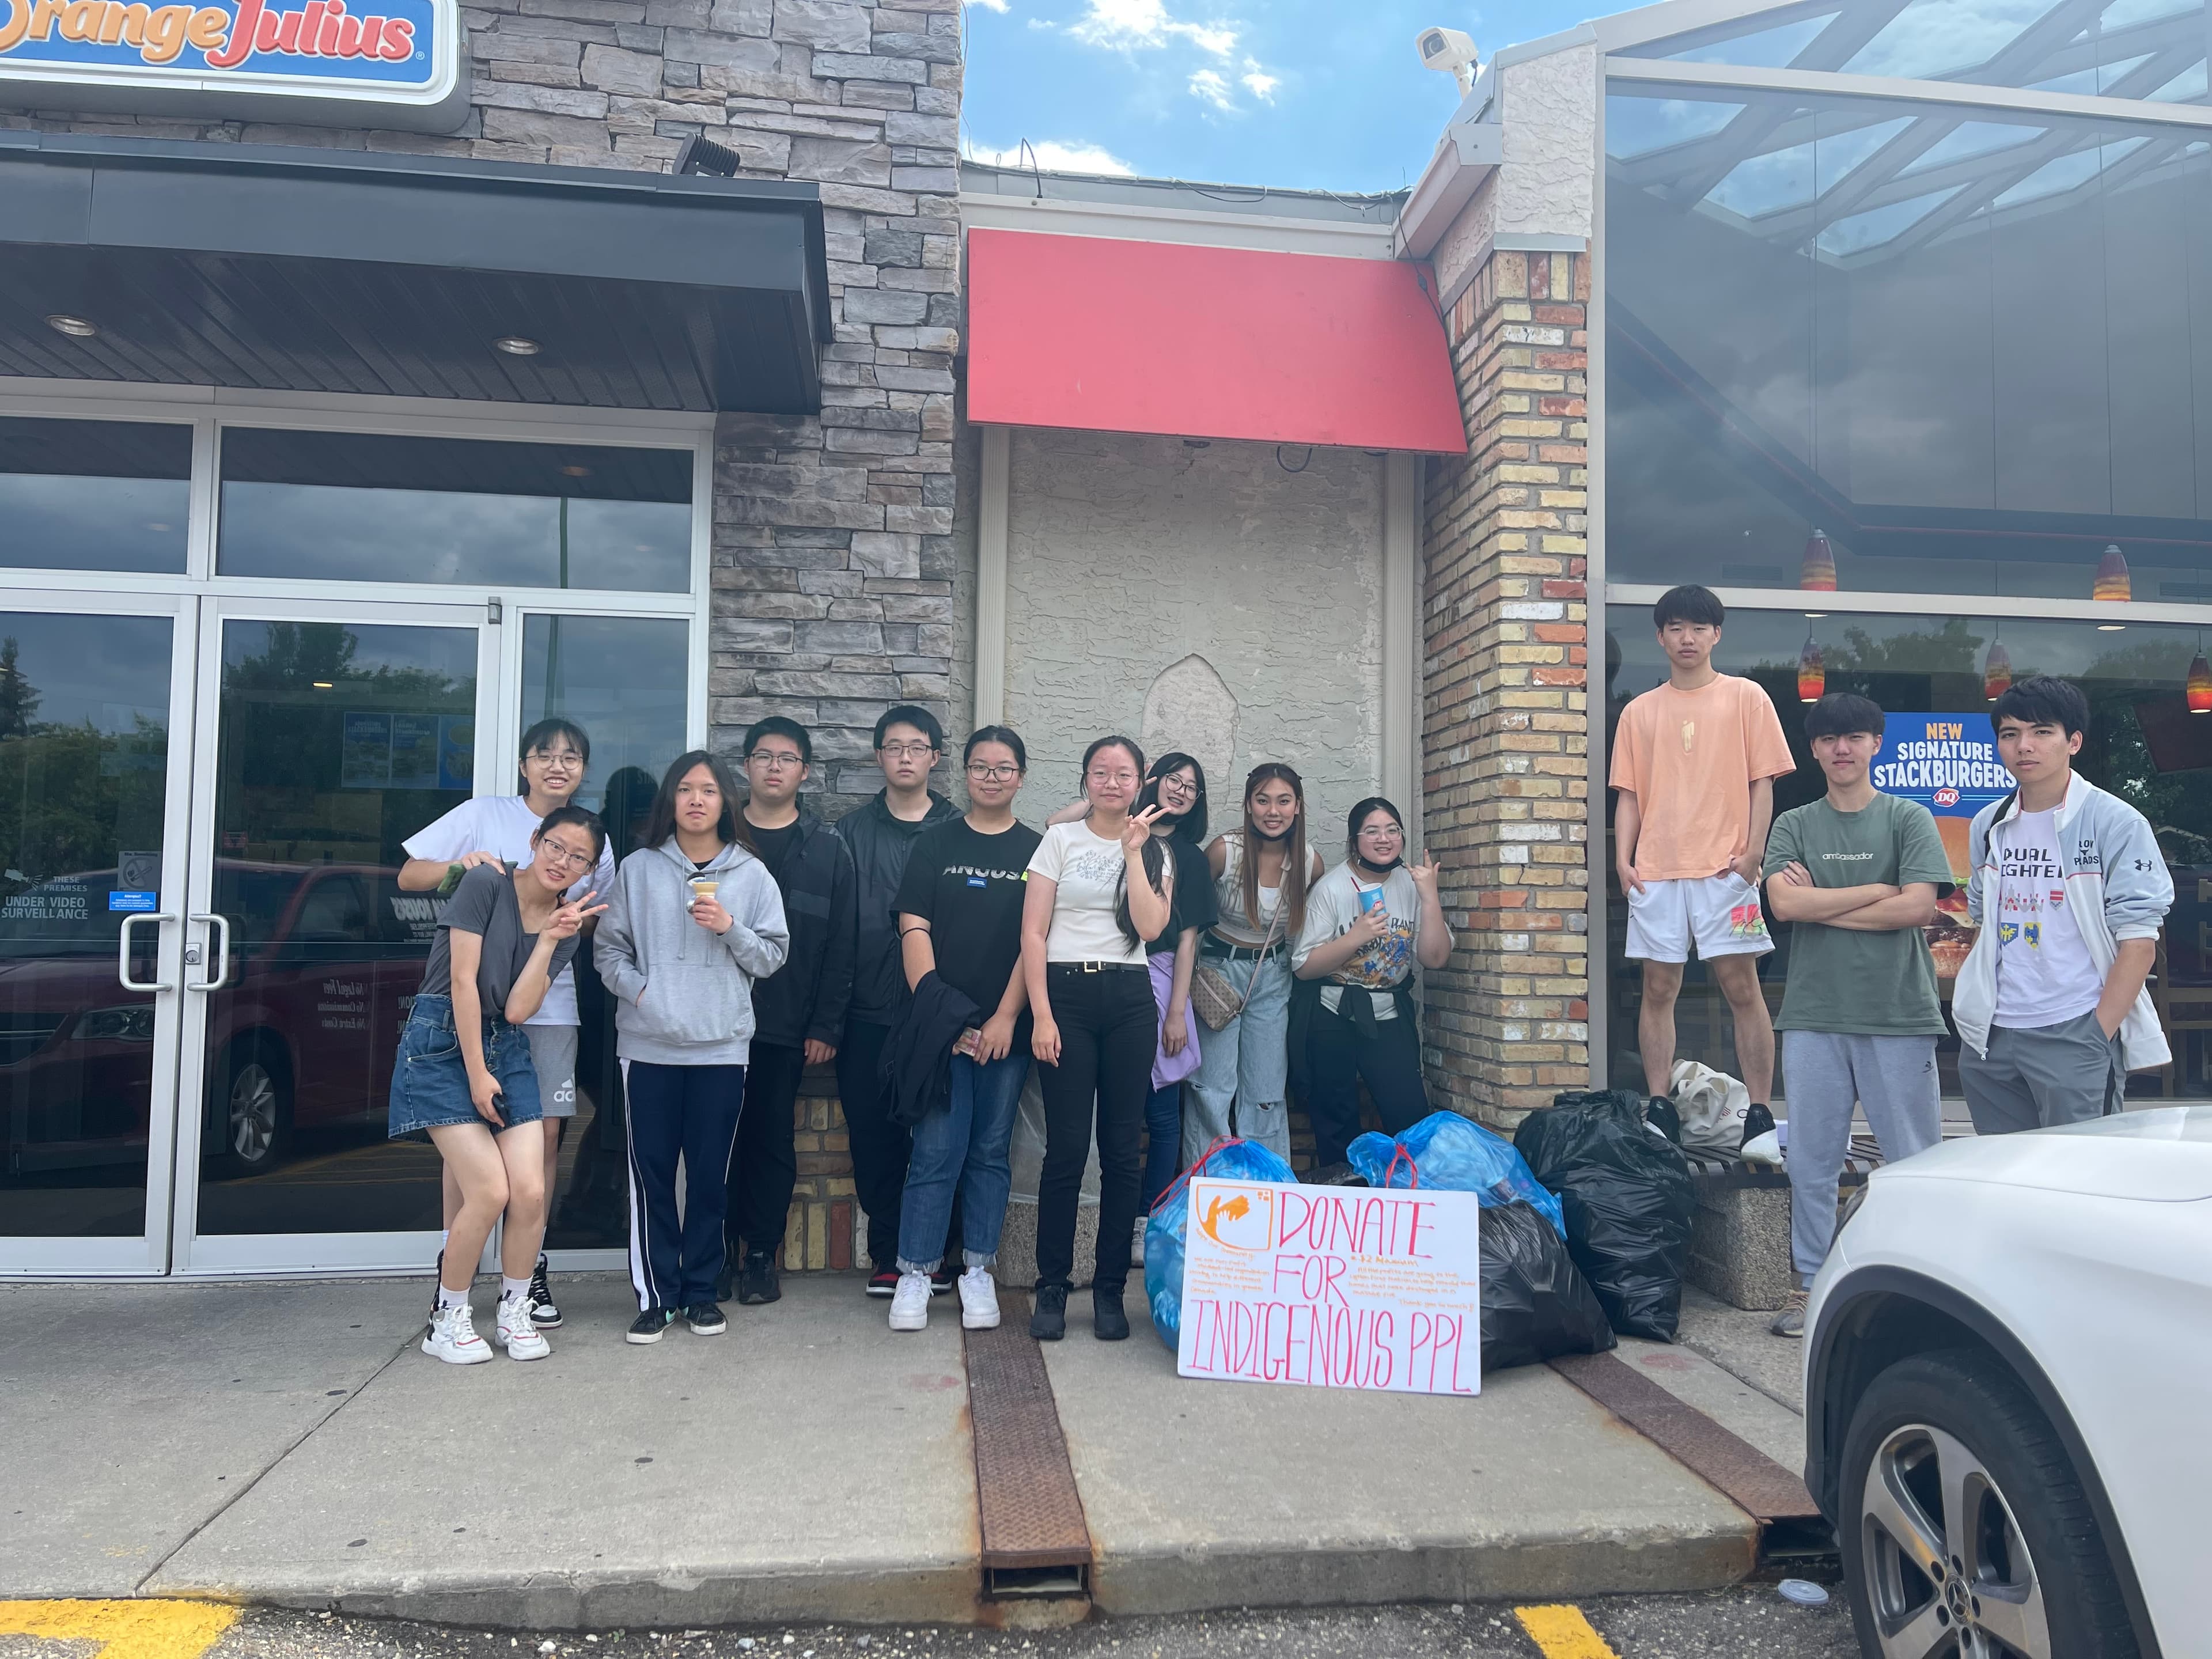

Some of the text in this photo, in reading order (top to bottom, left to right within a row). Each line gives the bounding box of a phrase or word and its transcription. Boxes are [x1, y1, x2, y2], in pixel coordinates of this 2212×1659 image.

[207, 0, 412, 67] Julius
[1926, 723, 1963, 740] NEW
[1897, 741, 1993, 761] SIGNATURE
[1874, 760, 2017, 788] STACKBURGERS
[2003, 848, 2052, 862] DUAL
[2001, 864, 2062, 878] IGHTE
[5, 896, 85, 908] UNDER VIDEO
[1, 908, 88, 919] SURVEILLANCE
[1278, 1191, 1435, 1258] DONATE
[1274, 1253, 1349, 1306] FOR
[1187, 1299, 1472, 1392] INDIGENOUS PPL
